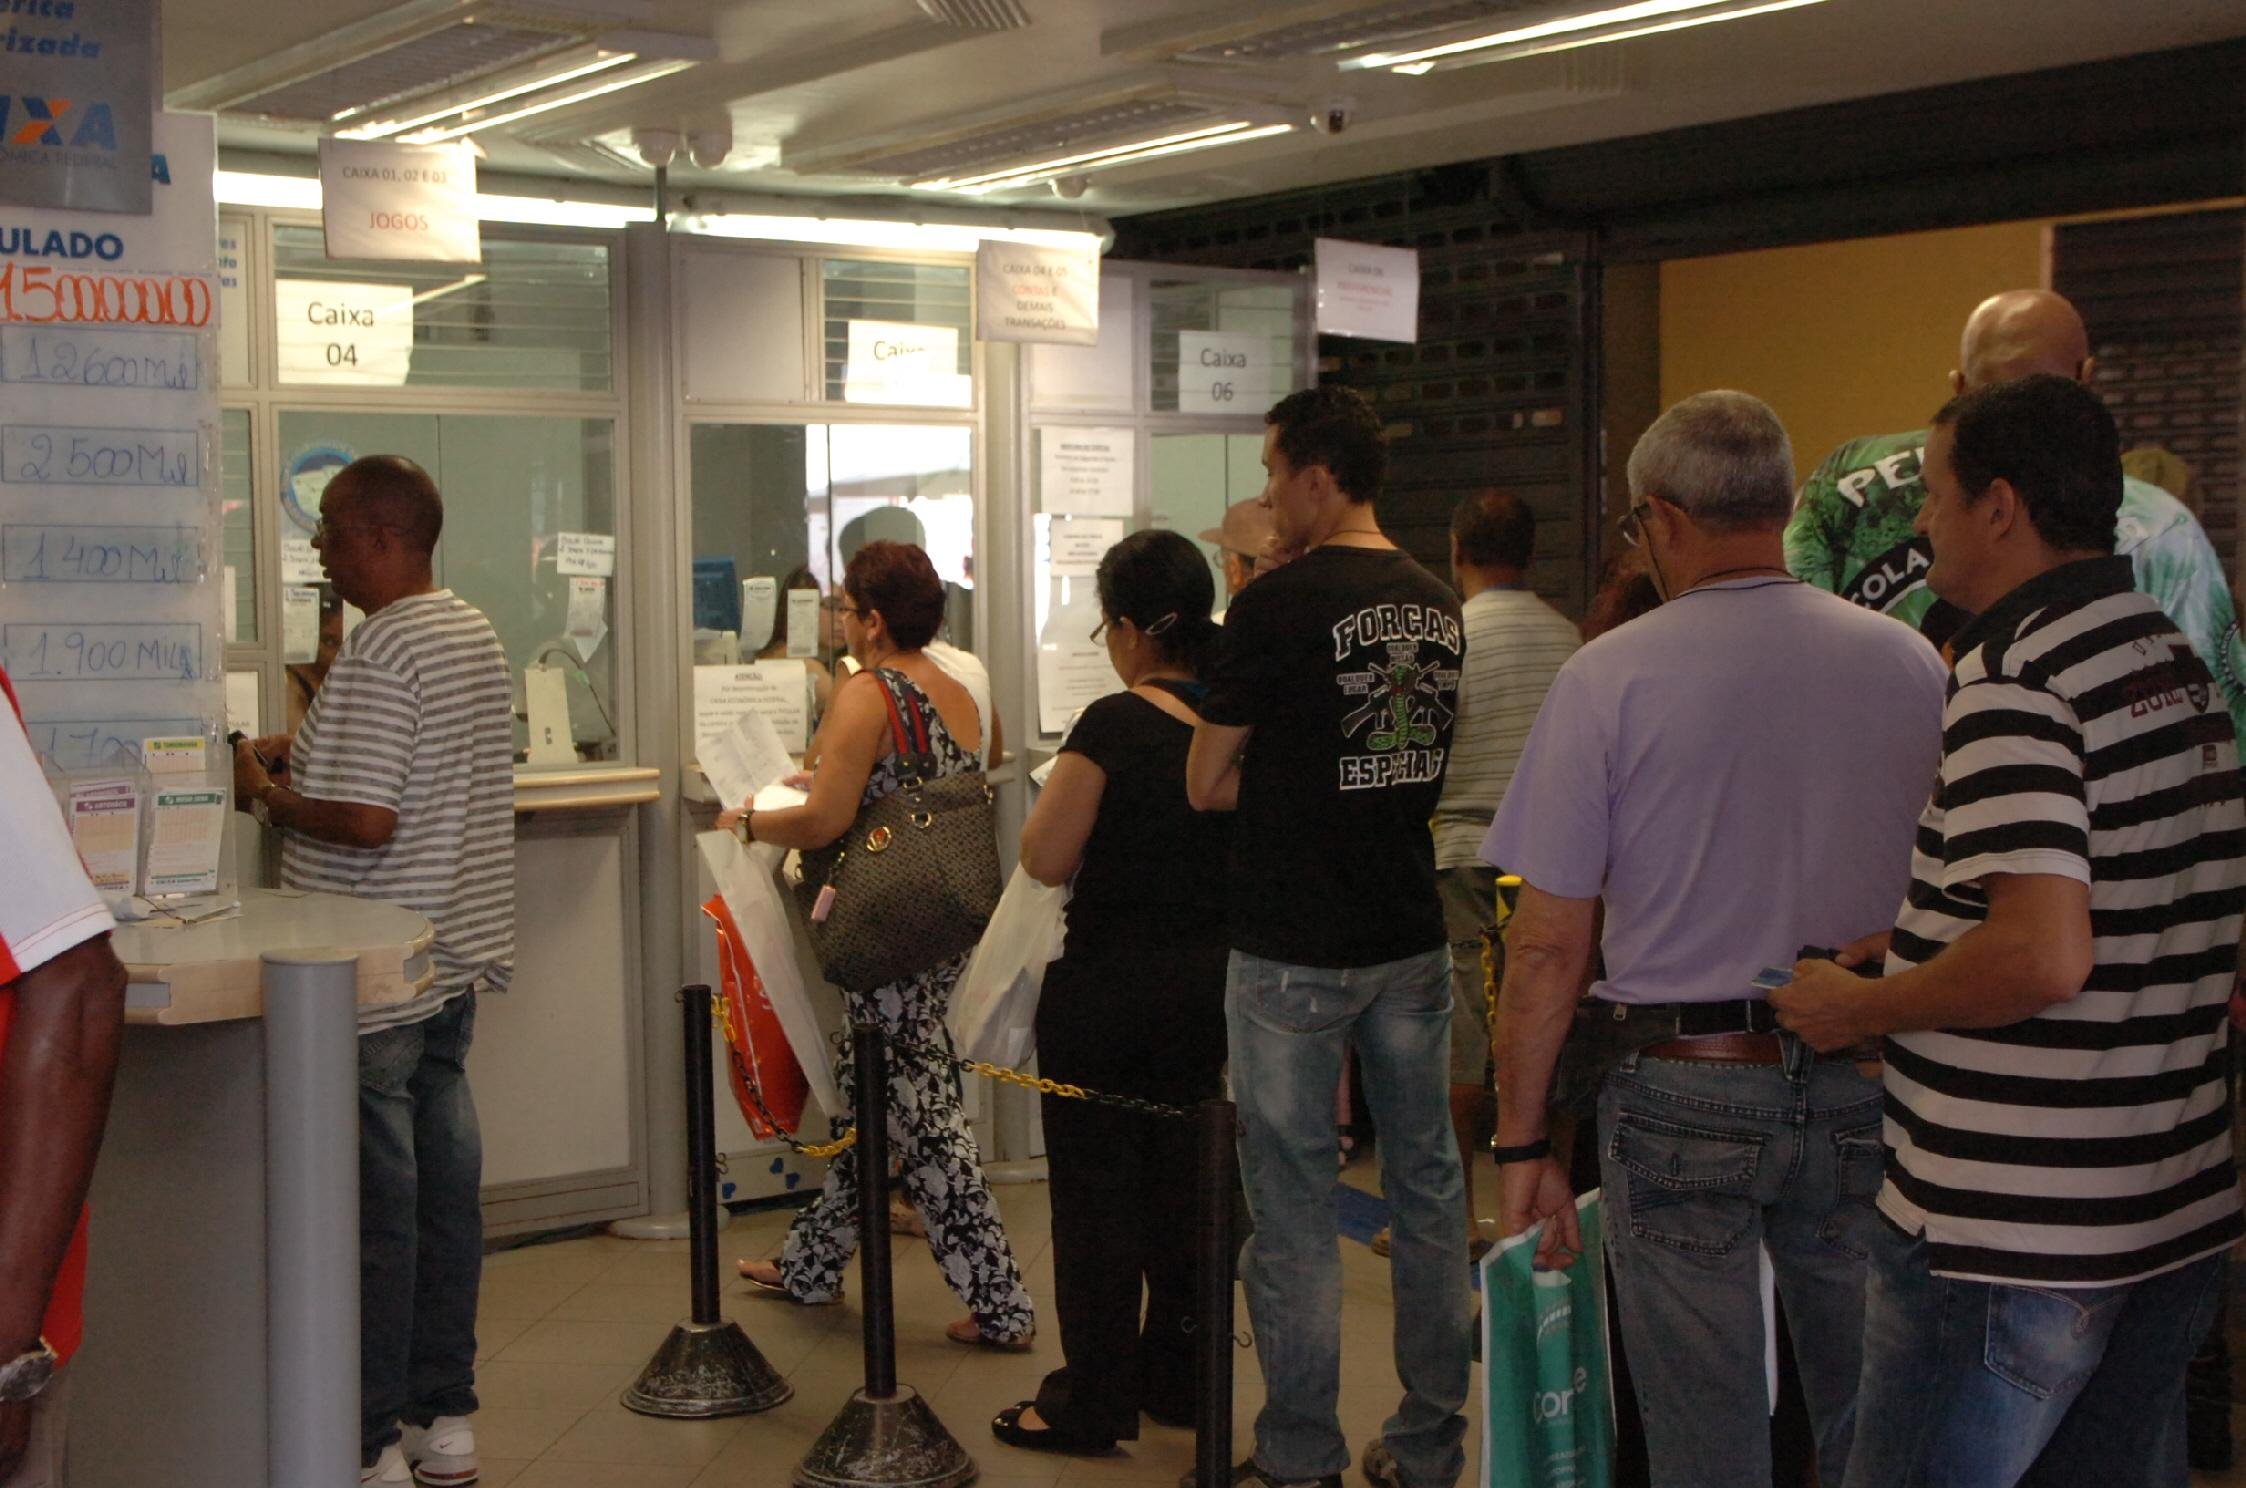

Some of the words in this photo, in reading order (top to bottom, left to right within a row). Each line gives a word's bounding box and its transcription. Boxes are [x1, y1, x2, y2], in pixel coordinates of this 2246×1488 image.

[342, 165, 379, 179] CAIXA
[369, 210, 430, 231] JOGOS
[0, 227, 125, 261] ULADO
[308, 302, 375, 328] Caixa
[1016, 300, 1054, 313] DEMAIS
[326, 342, 358, 367] 04
[1199, 347, 1247, 370] Caixa
[1211, 381, 1234, 402] 06
[1332, 603, 1460, 662] FORÇAS
